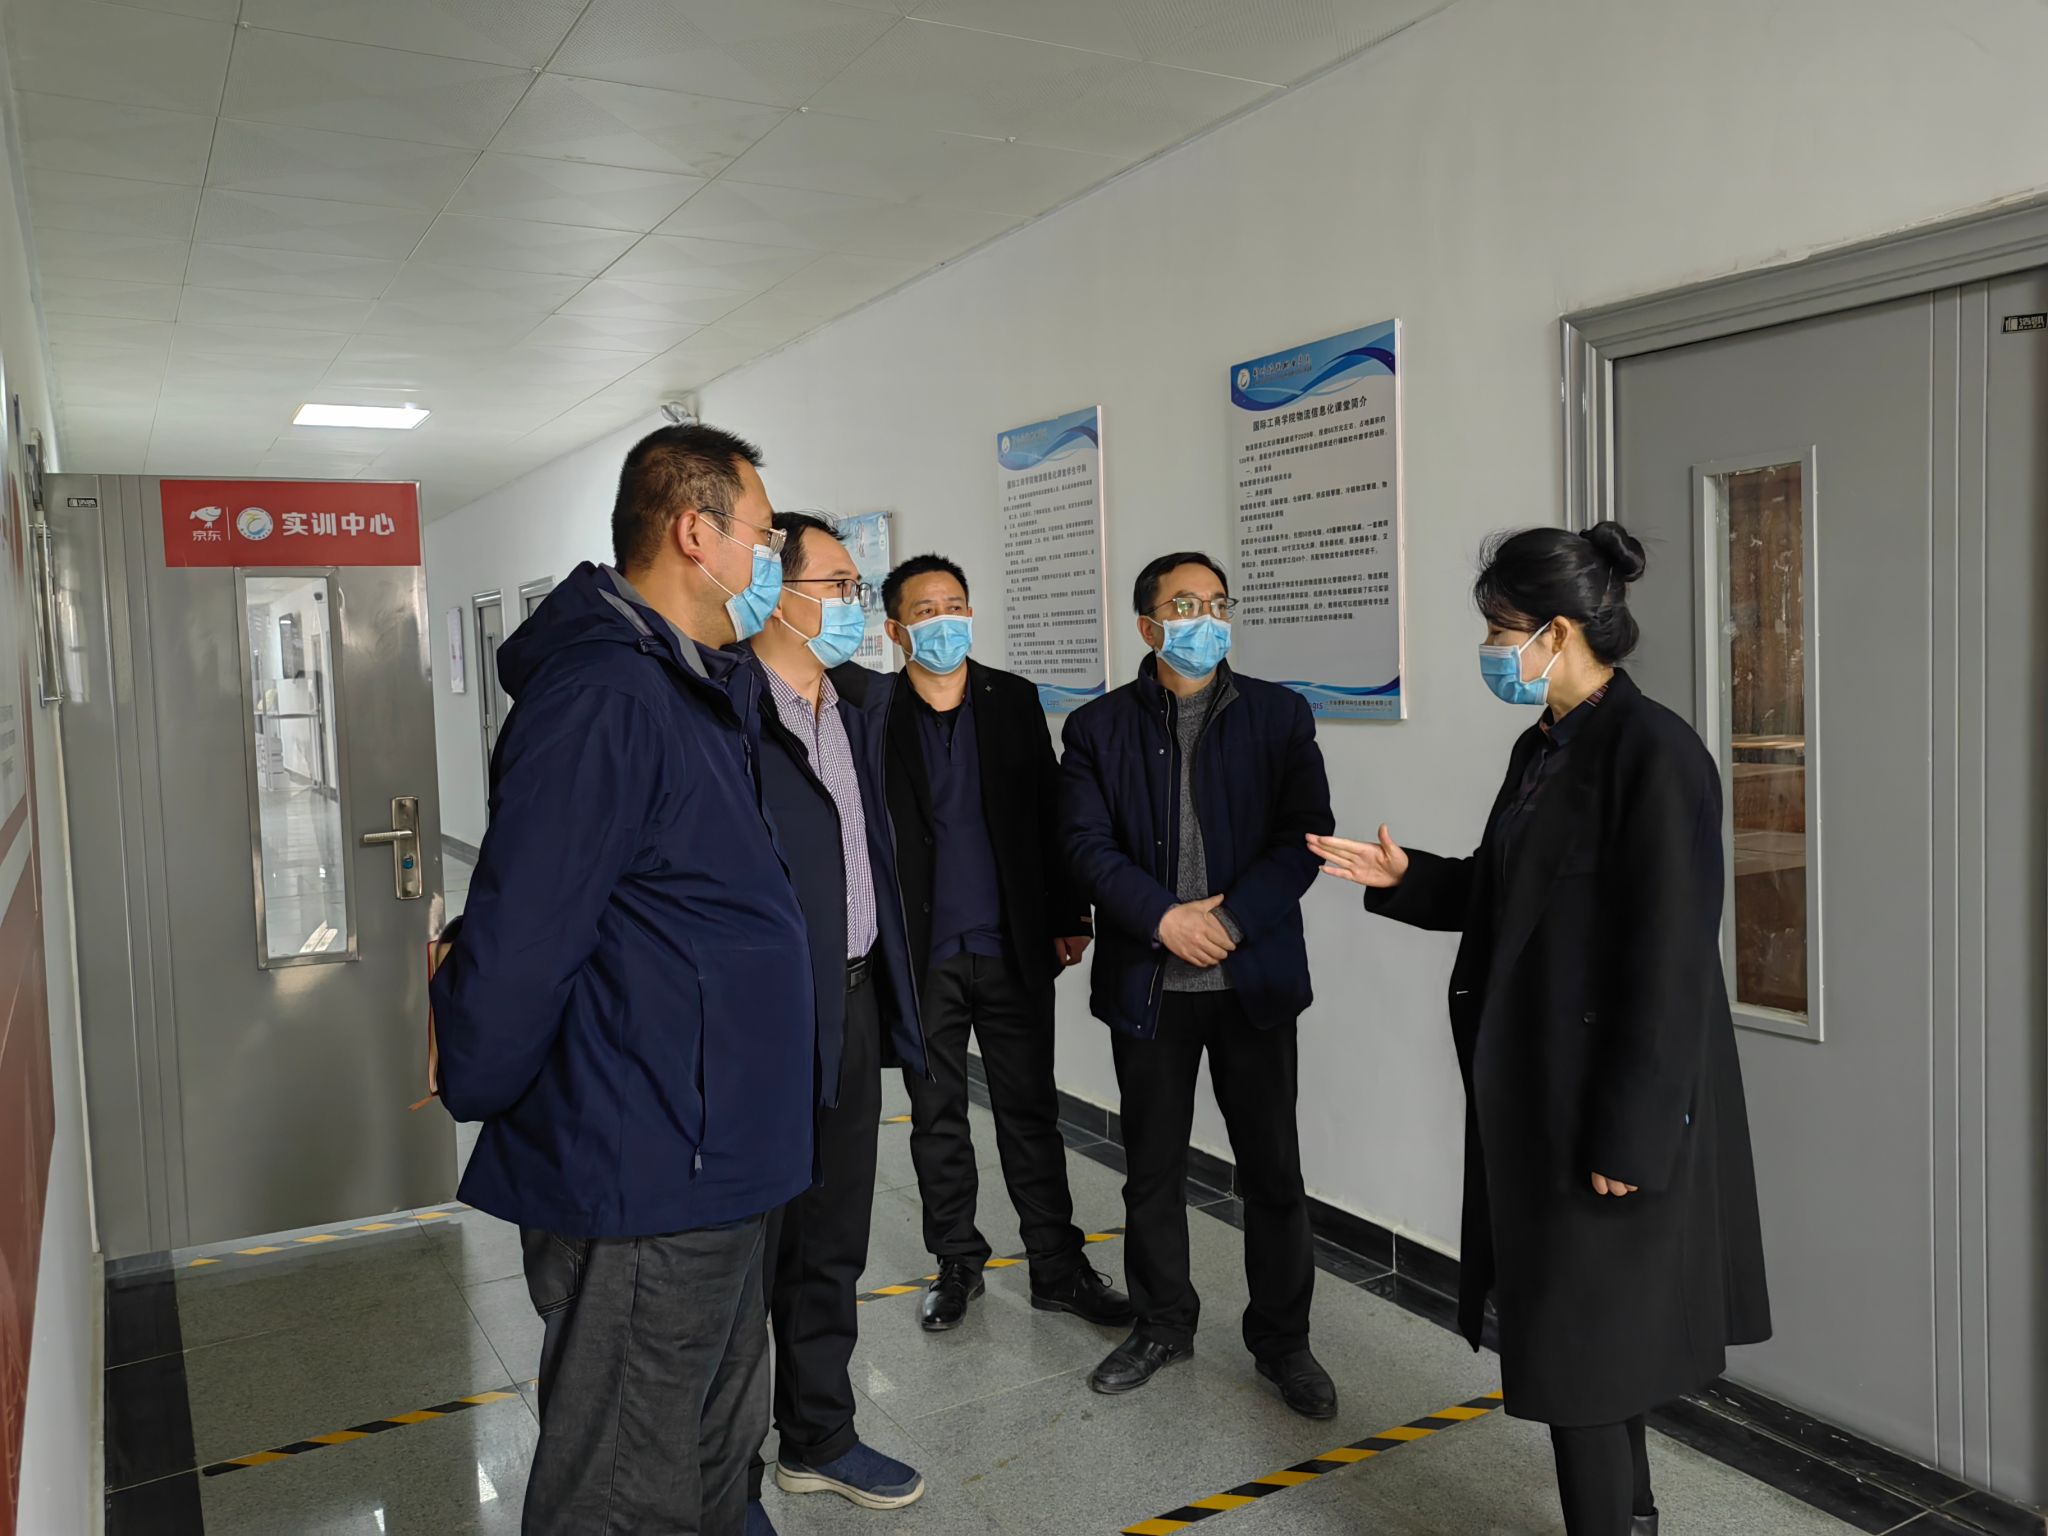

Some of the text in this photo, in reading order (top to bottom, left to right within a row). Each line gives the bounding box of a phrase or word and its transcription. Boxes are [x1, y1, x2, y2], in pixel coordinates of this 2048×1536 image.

[1252, 394, 1366, 432] 国际工商学院物流信息化课堂简介
[192, 531, 221, 541] 京东
[281, 512, 395, 536] 实训中心
